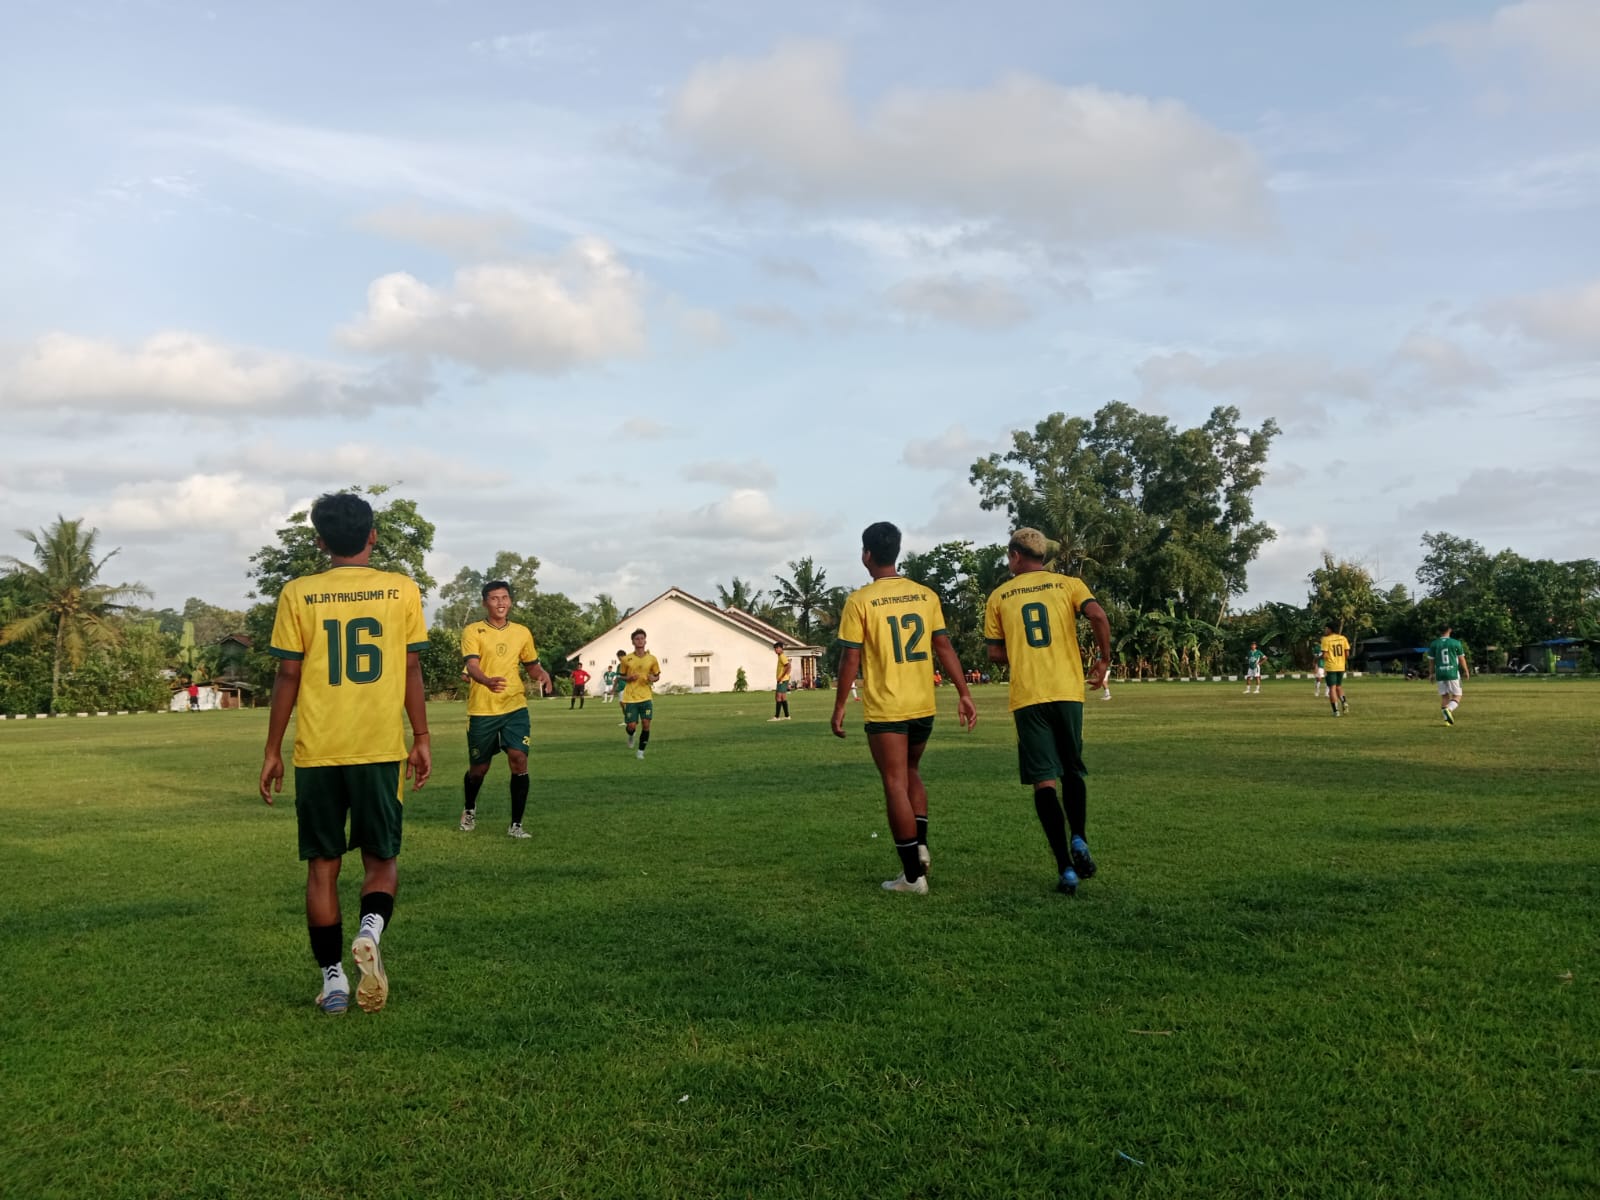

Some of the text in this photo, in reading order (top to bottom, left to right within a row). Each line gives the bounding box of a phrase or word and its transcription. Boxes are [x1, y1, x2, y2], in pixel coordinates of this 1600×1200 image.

[304, 589, 399, 605] WIJAYAKUSUMA FC
[886, 613, 928, 664] 12
[1021, 602, 1052, 648] 8
[323, 617, 383, 686] 16
[1332, 644, 1343, 657] 10
[1441, 648, 1449, 664] 6
